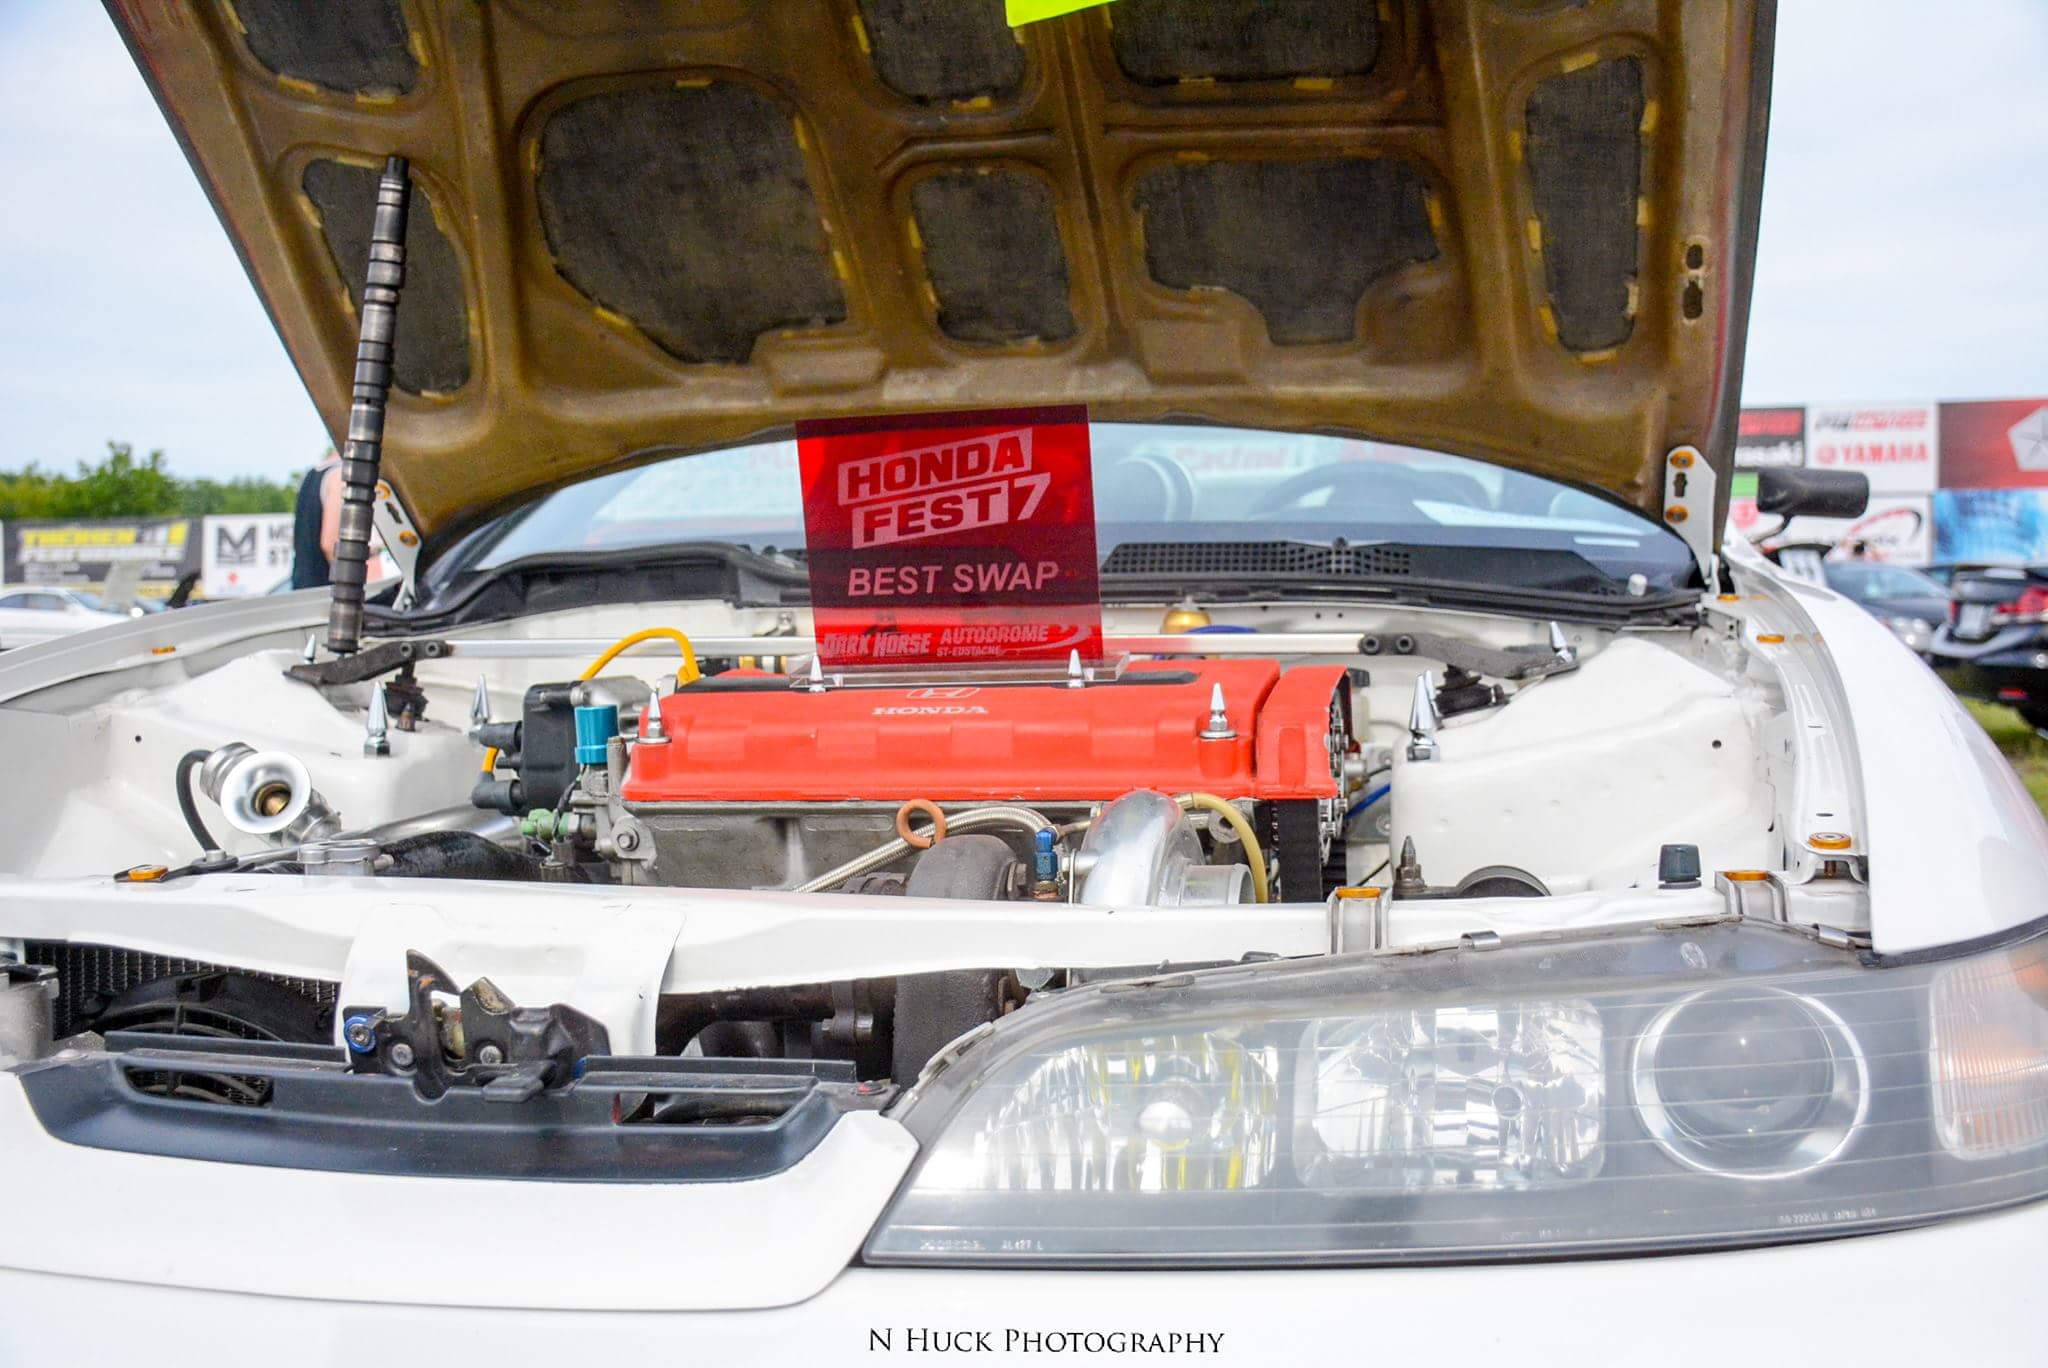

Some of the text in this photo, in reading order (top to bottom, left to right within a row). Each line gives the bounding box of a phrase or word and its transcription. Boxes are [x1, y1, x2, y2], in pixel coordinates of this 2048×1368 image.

[1842, 444, 1928, 464] YAMAHA
[847, 436, 1025, 500] HONDA
[862, 472, 1051, 543] FEST 7
[848, 561, 1059, 597] BEST SWAP
[822, 631, 933, 658] DARK HORSE
[939, 624, 1049, 645] AUTODROME
[871, 705, 988, 715] HONDA
